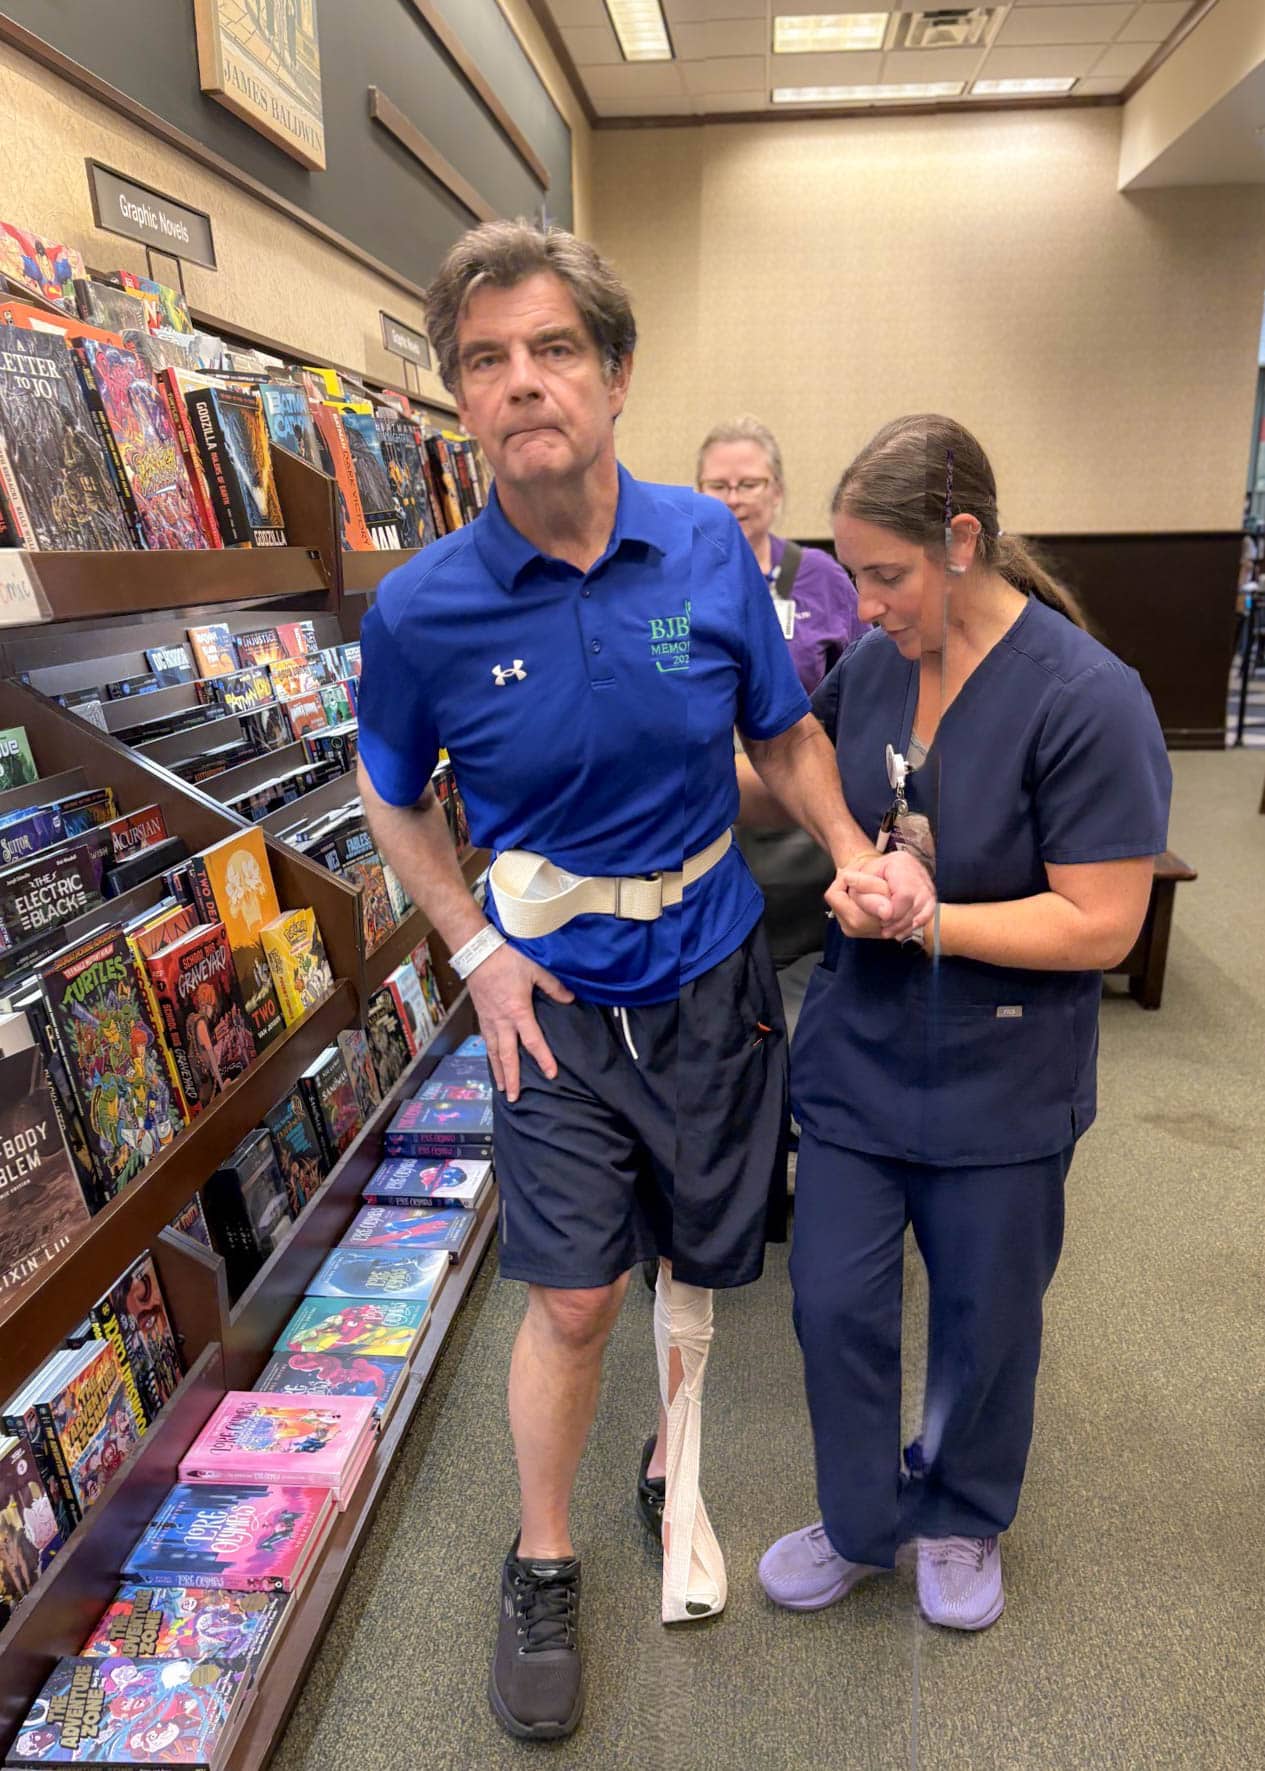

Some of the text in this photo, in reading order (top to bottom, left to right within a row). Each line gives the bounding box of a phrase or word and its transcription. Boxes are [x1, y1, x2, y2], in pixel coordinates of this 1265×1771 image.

[224, 59, 322, 152] JAMES BALDWIN
[119, 193, 190, 243] Graphic Novels
[16, 339, 26, 352] A
[0, 351, 63, 379] ETTER
[13, 375, 53, 399] TO JO
[196, 400, 218, 451] GODZILLA
[332, 412, 371, 546] BATMAN DARK VICTORY
[253, 529, 288, 547] GODZILLA
[243, 631, 277, 648] INJUSTICE
[648, 616, 690, 640] BJB
[650, 641, 690, 656] MEMO
[112, 816, 162, 853] ACURSIAN
[15, 874, 84, 914] ELECTRIC
[33, 873, 52, 888] THE
[197, 870, 219, 925] TWO DEA
[30, 894, 80, 928] BLACK
[62, 955, 128, 1005] TURTLES
[178, 944, 226, 1000] GRAVEYARD
[251, 999, 276, 1029] TWO
[162, 1003, 177, 1031] SCHOOL
[174, 1047, 199, 1100] GRAVEYARD
[2, 1121, 47, 1159] BODY
[0, 1256, 39, 1293] IXIN
[103, 1312, 127, 1364] CLOCK
[210, 1432, 240, 1455] LORE
[184, 1510, 227, 1546] LORE
[211, 1504, 257, 1553] OLYMPUS
[109, 1613, 129, 1641] THE
[139, 1610, 163, 1656] ZONE
[47, 1695, 69, 1724] THE
[61, 1664, 93, 1749] ADVENTURE
[80, 1688, 106, 1738] ZONE
